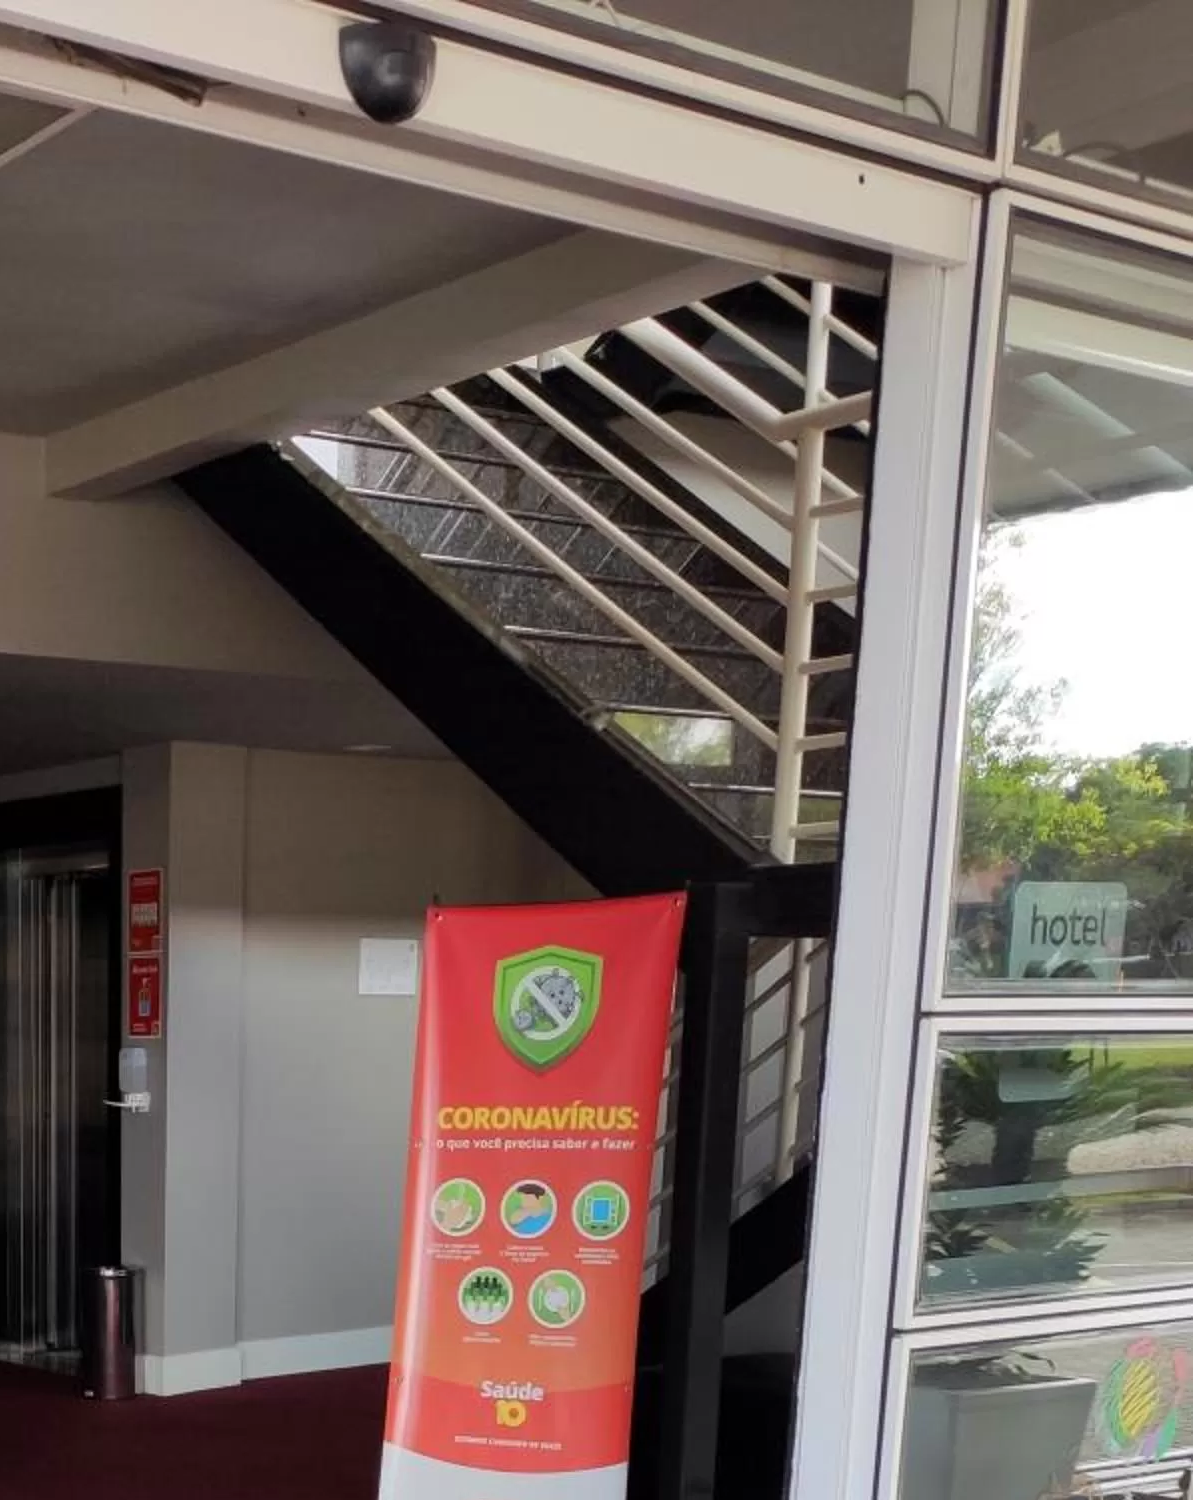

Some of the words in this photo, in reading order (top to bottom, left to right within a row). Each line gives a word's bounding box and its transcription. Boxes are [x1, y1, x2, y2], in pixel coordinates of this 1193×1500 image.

[1030, 903, 1106, 946] hotel
[438, 1100, 639, 1130] CORONAVÍRUS:
[436, 1140, 445, 1149] o
[446, 1140, 470, 1151] que
[473, 1137, 501, 1149] você
[504, 1137, 550, 1151] precisa
[552, 1137, 588, 1149] saber
[602, 1138, 635, 1150] fazer
[480, 1380, 544, 1401] Saúde
[495, 1399, 527, 1428] 10
